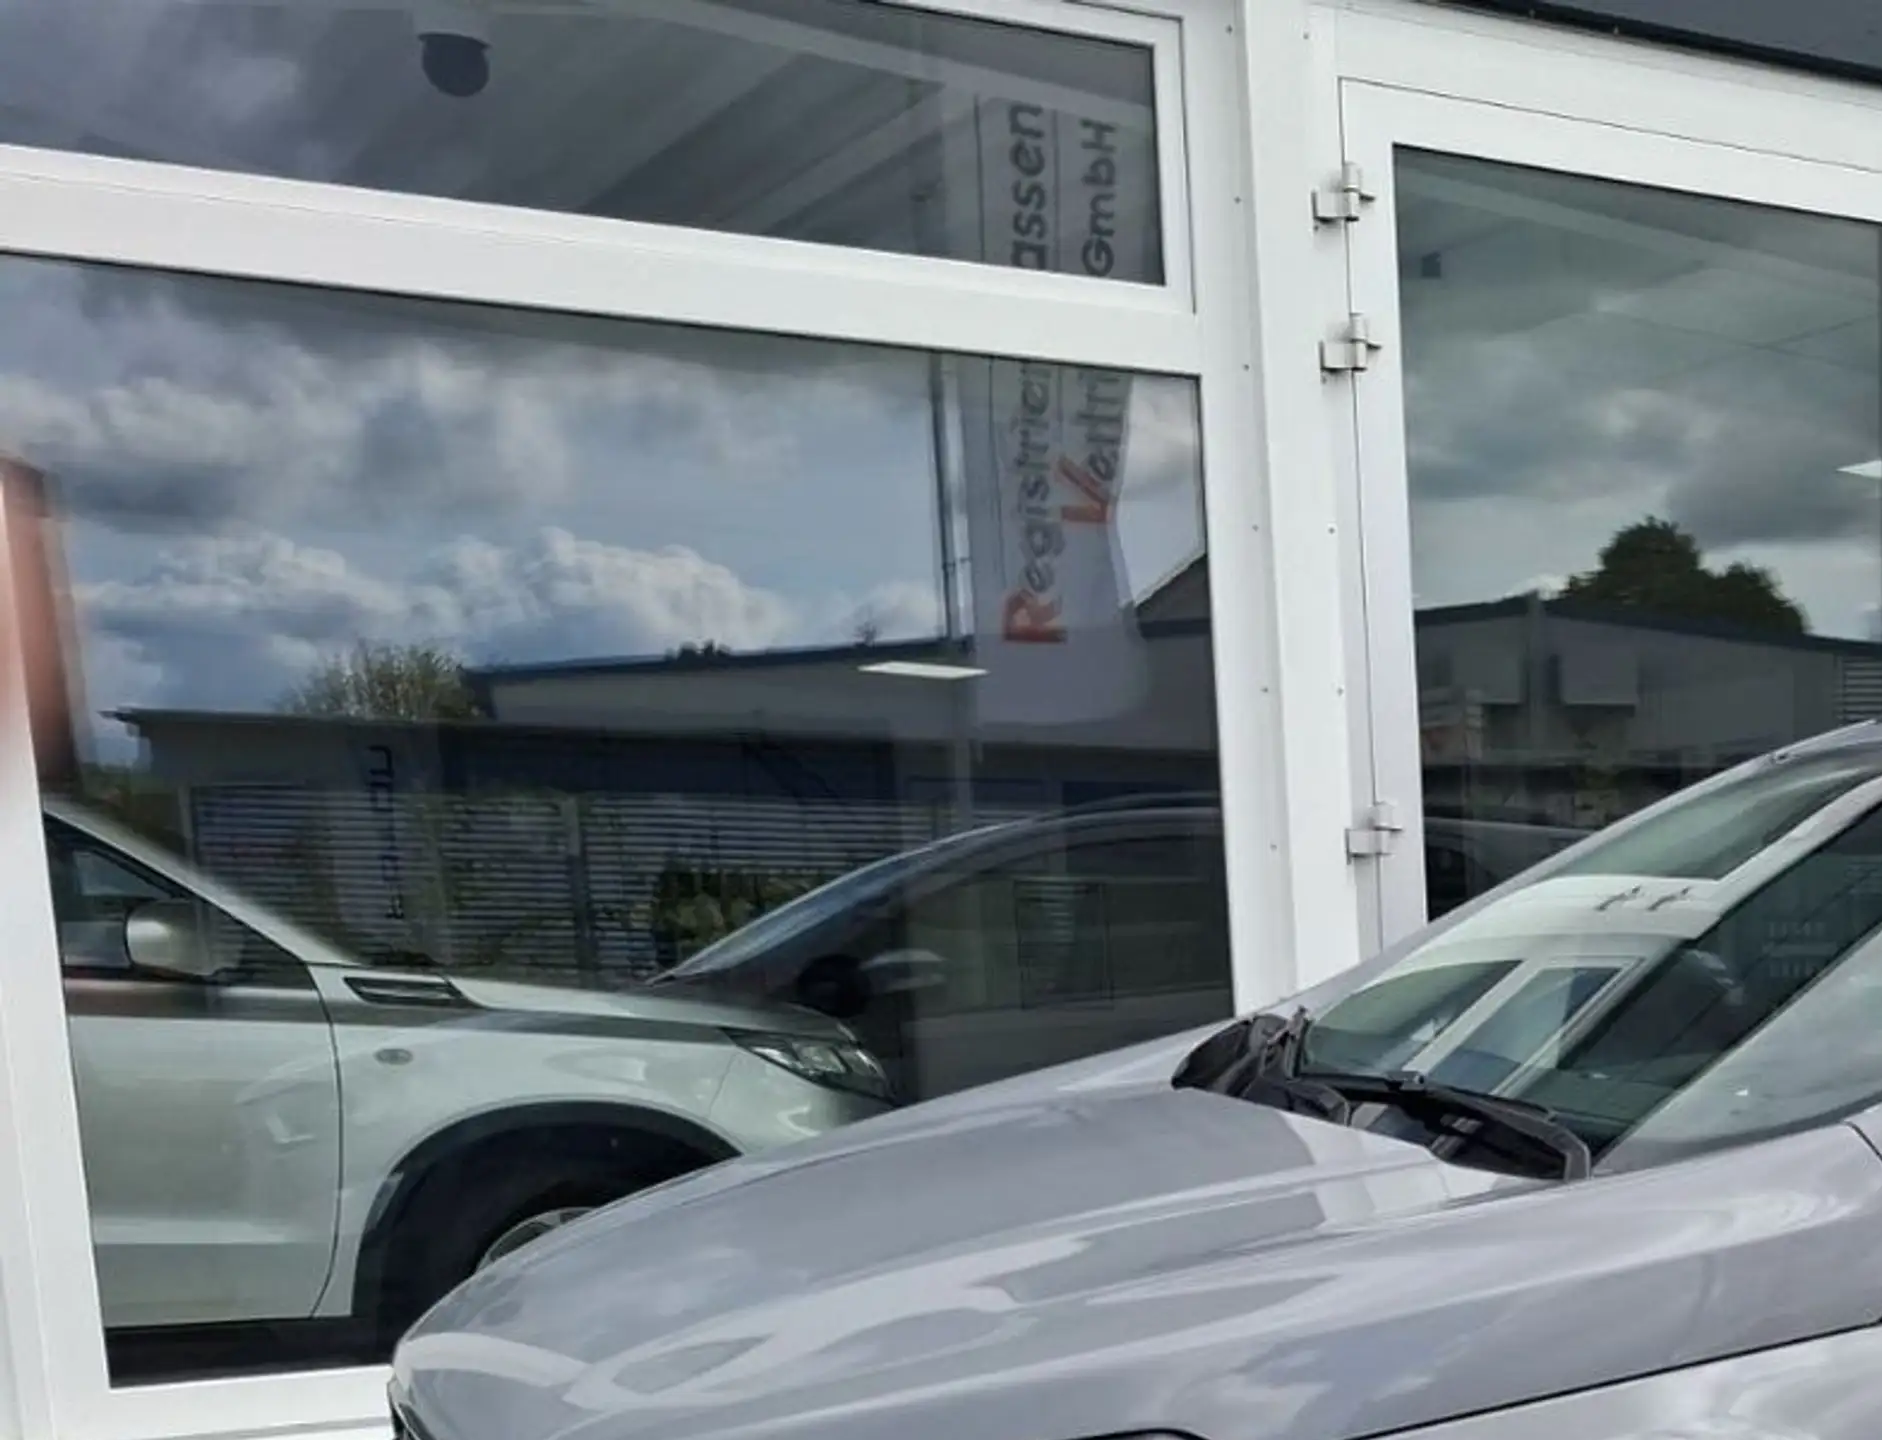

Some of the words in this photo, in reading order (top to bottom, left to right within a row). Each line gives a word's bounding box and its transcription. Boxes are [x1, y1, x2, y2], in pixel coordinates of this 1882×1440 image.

[1009, 103, 1047, 272] assen
[1080, 117, 1116, 278] GmbH
[1056, 372, 1121, 523] Vertri
